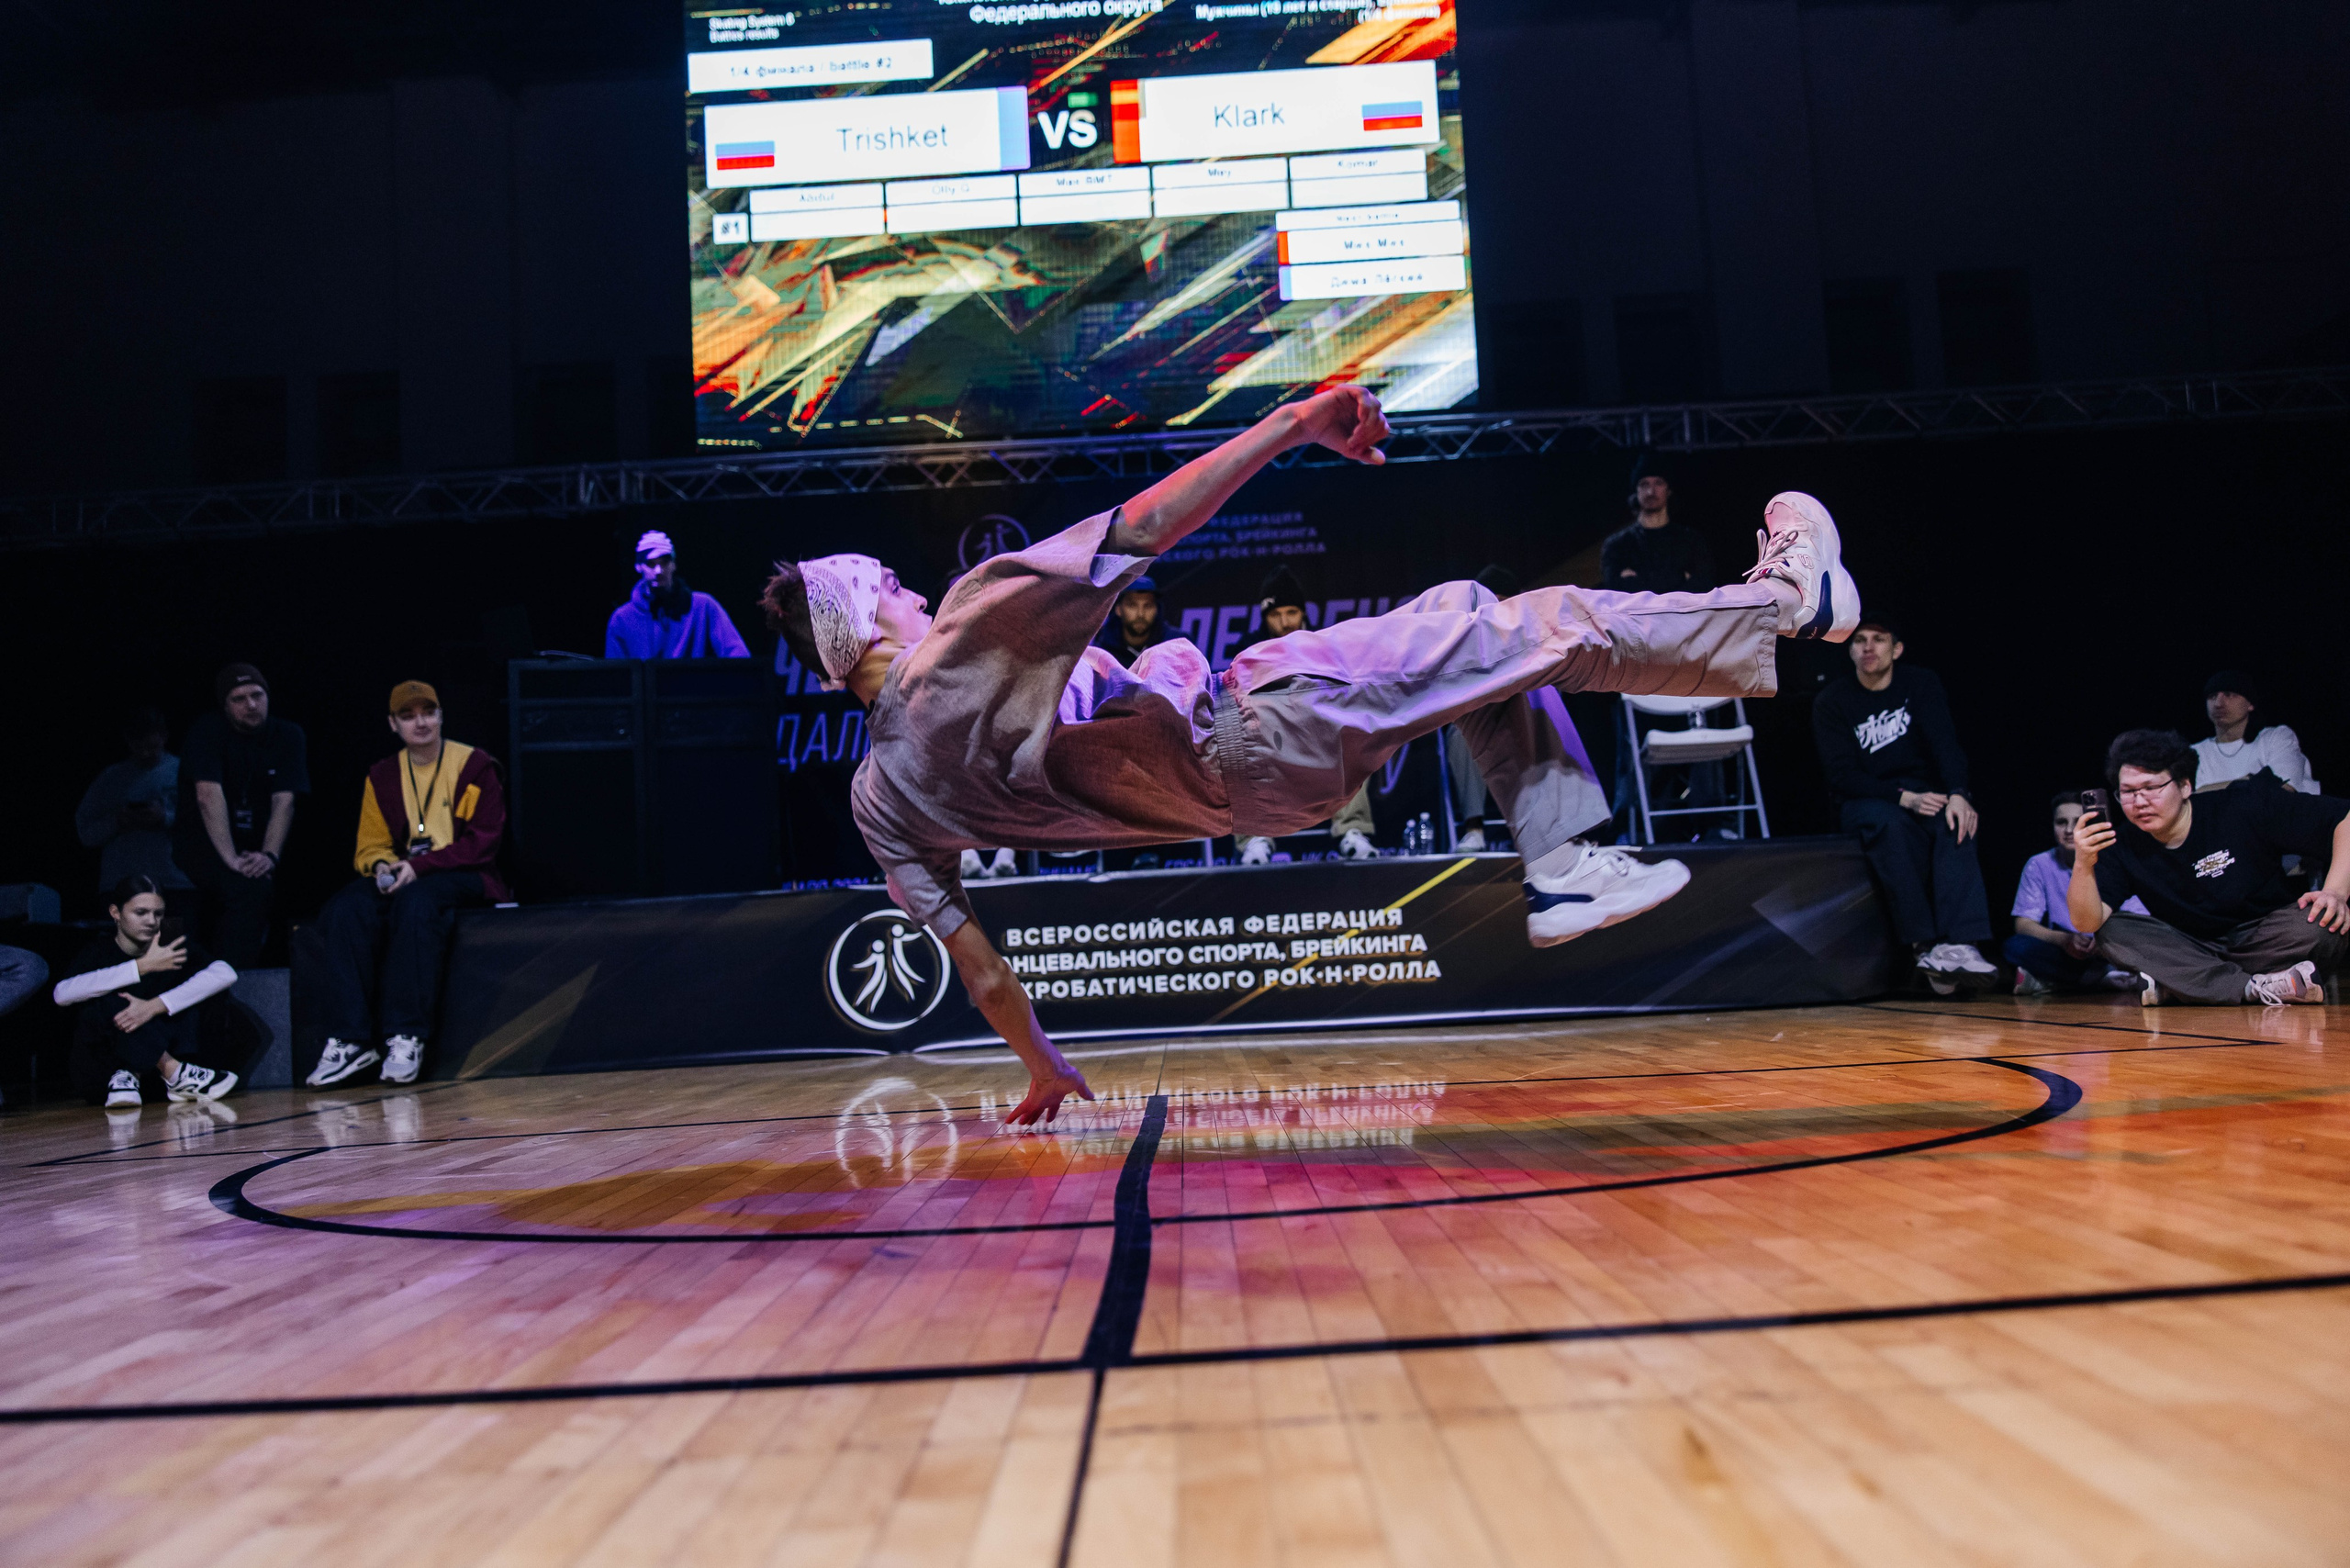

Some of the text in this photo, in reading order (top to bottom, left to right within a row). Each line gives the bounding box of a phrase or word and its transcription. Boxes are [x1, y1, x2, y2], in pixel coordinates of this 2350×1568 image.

[969, 0, 1164, 25] Федерального округа
[1037, 109, 1098, 149] VS
[1214, 103, 1286, 129] Klark
[836, 123, 949, 152] Trishket
[721, 220, 741, 236] #1
[1006, 908, 1404, 947] ВСЕРОССИЙСКАЯ ФЕДЕРАЦИЯ
[1188, 941, 1287, 965] СПОРТА,
[1291, 934, 1428, 958] БРЕЙКИНГА
